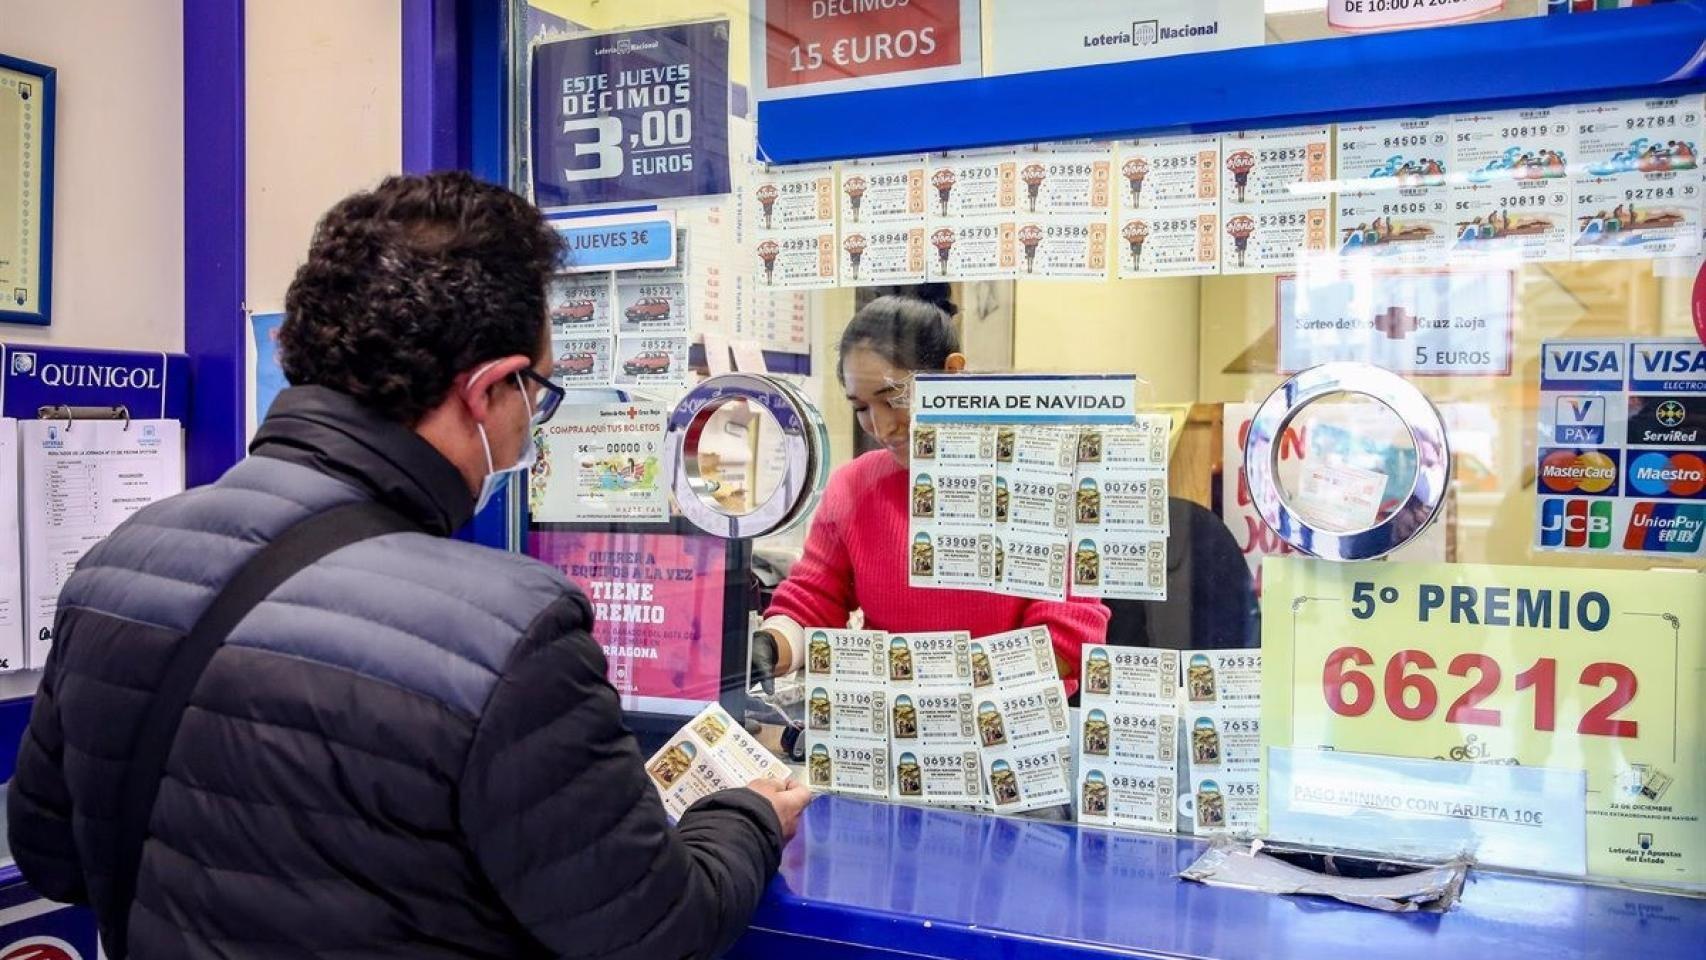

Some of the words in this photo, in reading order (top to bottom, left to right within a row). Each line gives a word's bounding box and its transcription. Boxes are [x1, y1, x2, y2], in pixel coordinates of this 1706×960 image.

[1345, 1, 1363, 13] DE
[1084, 32, 1130, 47] Loteria
[1160, 21, 1218, 39] Nacional
[790, 43, 823, 72] 15
[832, 27, 936, 65] €UROS
[562, 74, 608, 94] ESTE
[615, 64, 690, 88] JUEVES
[562, 82, 691, 115] DÉCIMOS
[1579, 124, 1594, 134] 5€
[1626, 114, 1675, 129] 92784
[1457, 133, 1471, 142] 5€
[1502, 126, 1548, 139] 30819
[1342, 142, 1356, 150] 5€
[1384, 135, 1427, 147] 84505
[1260, 148, 1306, 161] 52852
[632, 153, 693, 176] EUROS
[1153, 156, 1197, 168] 52855
[960, 167, 998, 179] 45701
[1050, 165, 1091, 176] 03586
[870, 175, 908, 186] 58948
[781, 183, 817, 193] 42913
[1578, 194, 1593, 204] 5€
[1625, 186, 1674, 200] 92784
[1456, 201, 1470, 210] 5€
[1500, 194, 1546, 207] 30819
[1341, 207, 1355, 216] 5€
[1383, 202, 1426, 214] 84505
[1153, 219, 1197, 231] 52855
[1260, 214, 1306, 226] 52852
[960, 227, 998, 238] 45701
[1047, 226, 1088, 236] 03586
[575, 231, 627, 250] JUEVES
[631, 230, 649, 246] 3€
[783, 238, 818, 249] 42913
[871, 233, 908, 243] 58948
[1335, 318, 1350, 329] de
[1418, 317, 1449, 329] Cruz
[1454, 317, 1486, 331] Roja
[565, 341, 597, 350] 45708
[1415, 347, 1428, 365] 5
[1436, 351, 1491, 365] EUROS
[1551, 350, 1619, 372] VISA
[1639, 351, 1706, 372] VISA
[41, 364, 161, 389] QUINIGOL
[922, 395, 1000, 409] LOTERIA
[1006, 395, 1032, 409] DE
[1036, 395, 1126, 409] NAVIDAD
[1568, 400, 1592, 421] V
[550, 426, 584, 434] COMPRA
[607, 424, 621, 432] TUS
[623, 423, 660, 432] BOLETOS
[1564, 429, 1593, 440] PAY
[1643, 430, 1697, 442] ServiRed
[607, 443, 640, 453] 00000
[1543, 465, 1615, 479] MasterCard
[1638, 467, 1701, 481] Maestro
[938, 477, 977, 489] 53909
[1014, 483, 1055, 496] 27280
[1104, 482, 1147, 493] 00765
[1541, 514, 1610, 533] JCB
[1633, 513, 1703, 535] UnionPay
[937, 537, 977, 548] 53909
[1103, 544, 1147, 554] 00765
[1009, 542, 1050, 557] 27280
[667, 568, 693, 580] VEZ
[590, 581, 654, 601] TIENE
[1351, 582, 1399, 619] 5º
[1418, 583, 1611, 632] PREMIO
[835, 636, 871, 647] 13106
[914, 639, 953, 650] 06952
[990, 635, 1031, 653] 35651
[1115, 654, 1158, 666] 68364
[835, 692, 871, 704] 13106
[1323, 647, 1639, 739] 66212
[919, 697, 958, 708] 06952
[1003, 695, 1043, 712] 35651
[1113, 715, 1157, 728] 68364
[732, 733, 769, 769] 49440
[835, 749, 871, 761] 13106
[924, 756, 962, 766] 06952
[1016, 753, 1057, 769] 35651
[1112, 777, 1156, 790] 68364
[1228, 784, 1259, 794] 765
[1294, 786, 1335, 801] PAGO
[1406, 798, 1439, 811] CON
[1443, 801, 1509, 820] TARJETA
[1514, 810, 1544, 824] 10€
[1638, 856, 1665, 864] Estado
